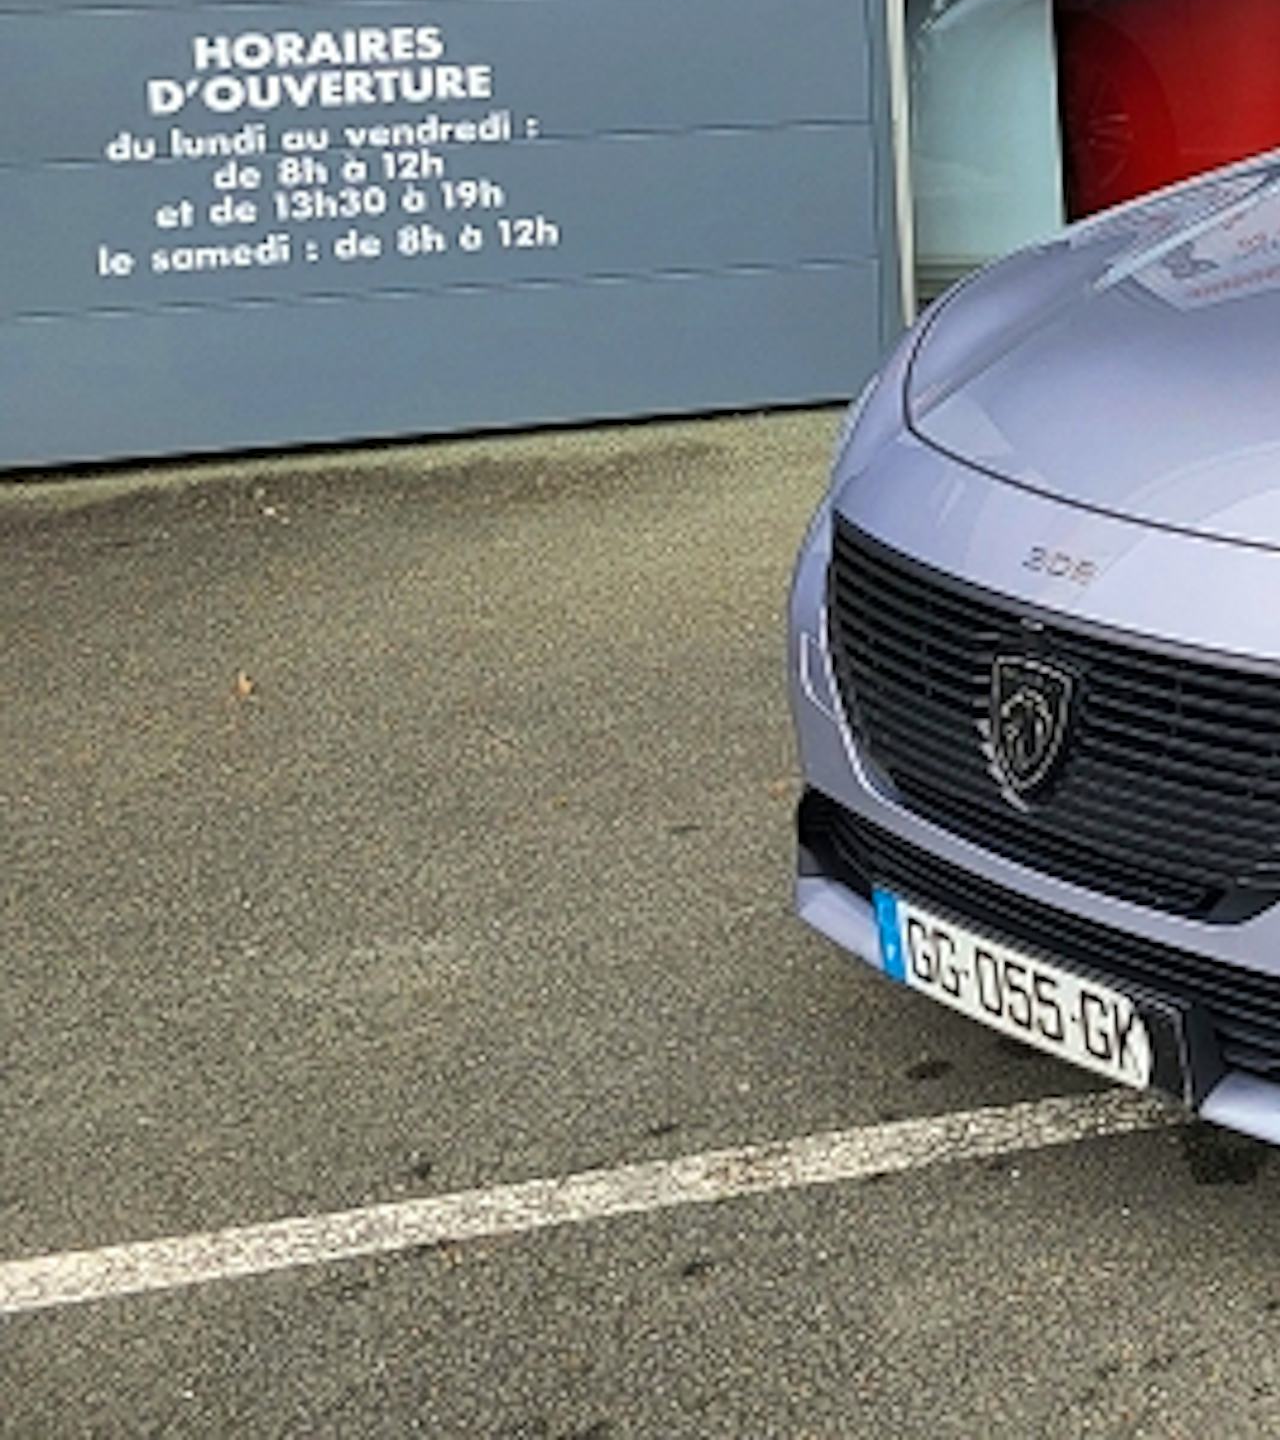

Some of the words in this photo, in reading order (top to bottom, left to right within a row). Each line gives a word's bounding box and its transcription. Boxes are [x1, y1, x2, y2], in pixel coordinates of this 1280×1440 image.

[194, 27, 442, 70] HORAIRES
[146, 65, 491, 115] D'OUVERTURE
[106, 132, 156, 161] du
[170, 123, 267, 160] lundi
[281, 126, 328, 152] au
[345, 112, 511, 148] vendredi
[213, 161, 260, 189] de
[279, 155, 328, 186] 8h
[344, 153, 366, 182] à
[382, 150, 444, 181] 12h
[157, 201, 193, 228] et
[210, 195, 256, 224] de
[275, 187, 386, 219] 13h30
[403, 184, 425, 213] à
[440, 179, 503, 211] 19h
[98, 246, 133, 276] le
[152, 235, 290, 273] samedi
[334, 229, 381, 259] de
[399, 226, 444, 253] 8h
[459, 221, 483, 250] à
[498, 217, 559, 248] 12h
